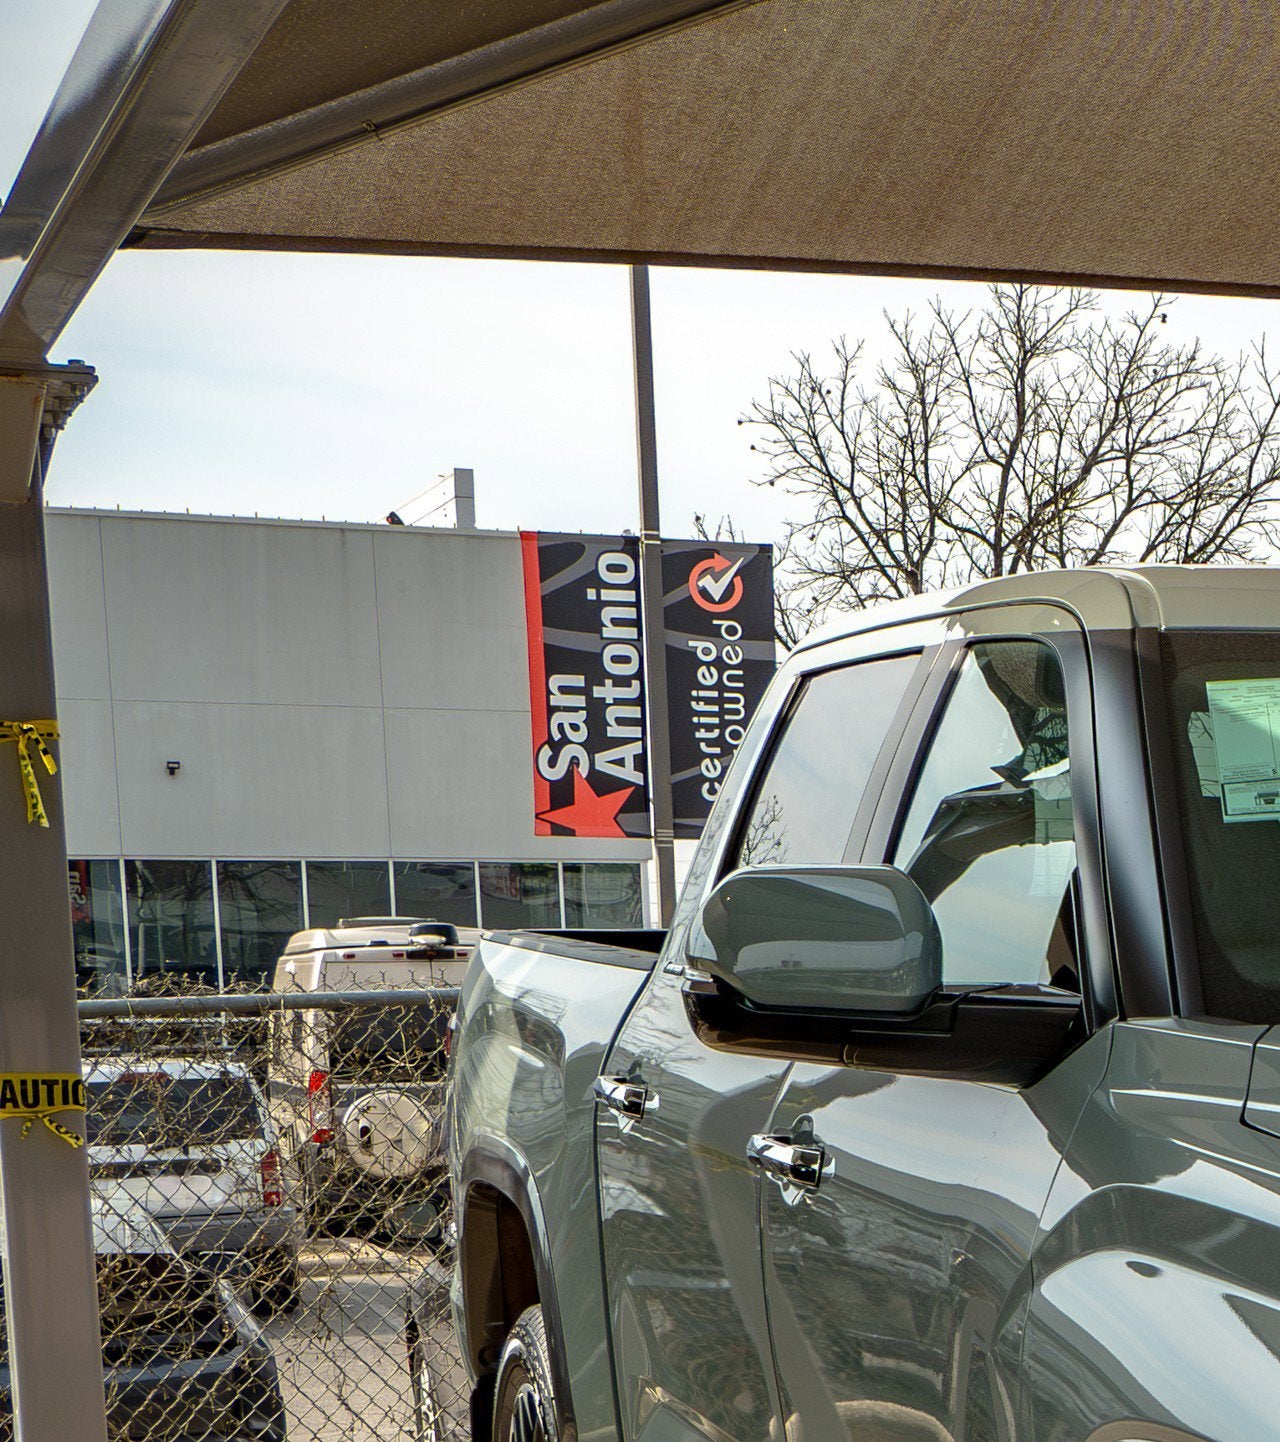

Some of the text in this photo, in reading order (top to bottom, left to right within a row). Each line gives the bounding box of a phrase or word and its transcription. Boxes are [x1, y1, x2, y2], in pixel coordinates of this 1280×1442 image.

[538, 674, 590, 782] San
[587, 551, 645, 786] Antonio
[688, 640, 722, 802] certified
[712, 619, 746, 747] owned
